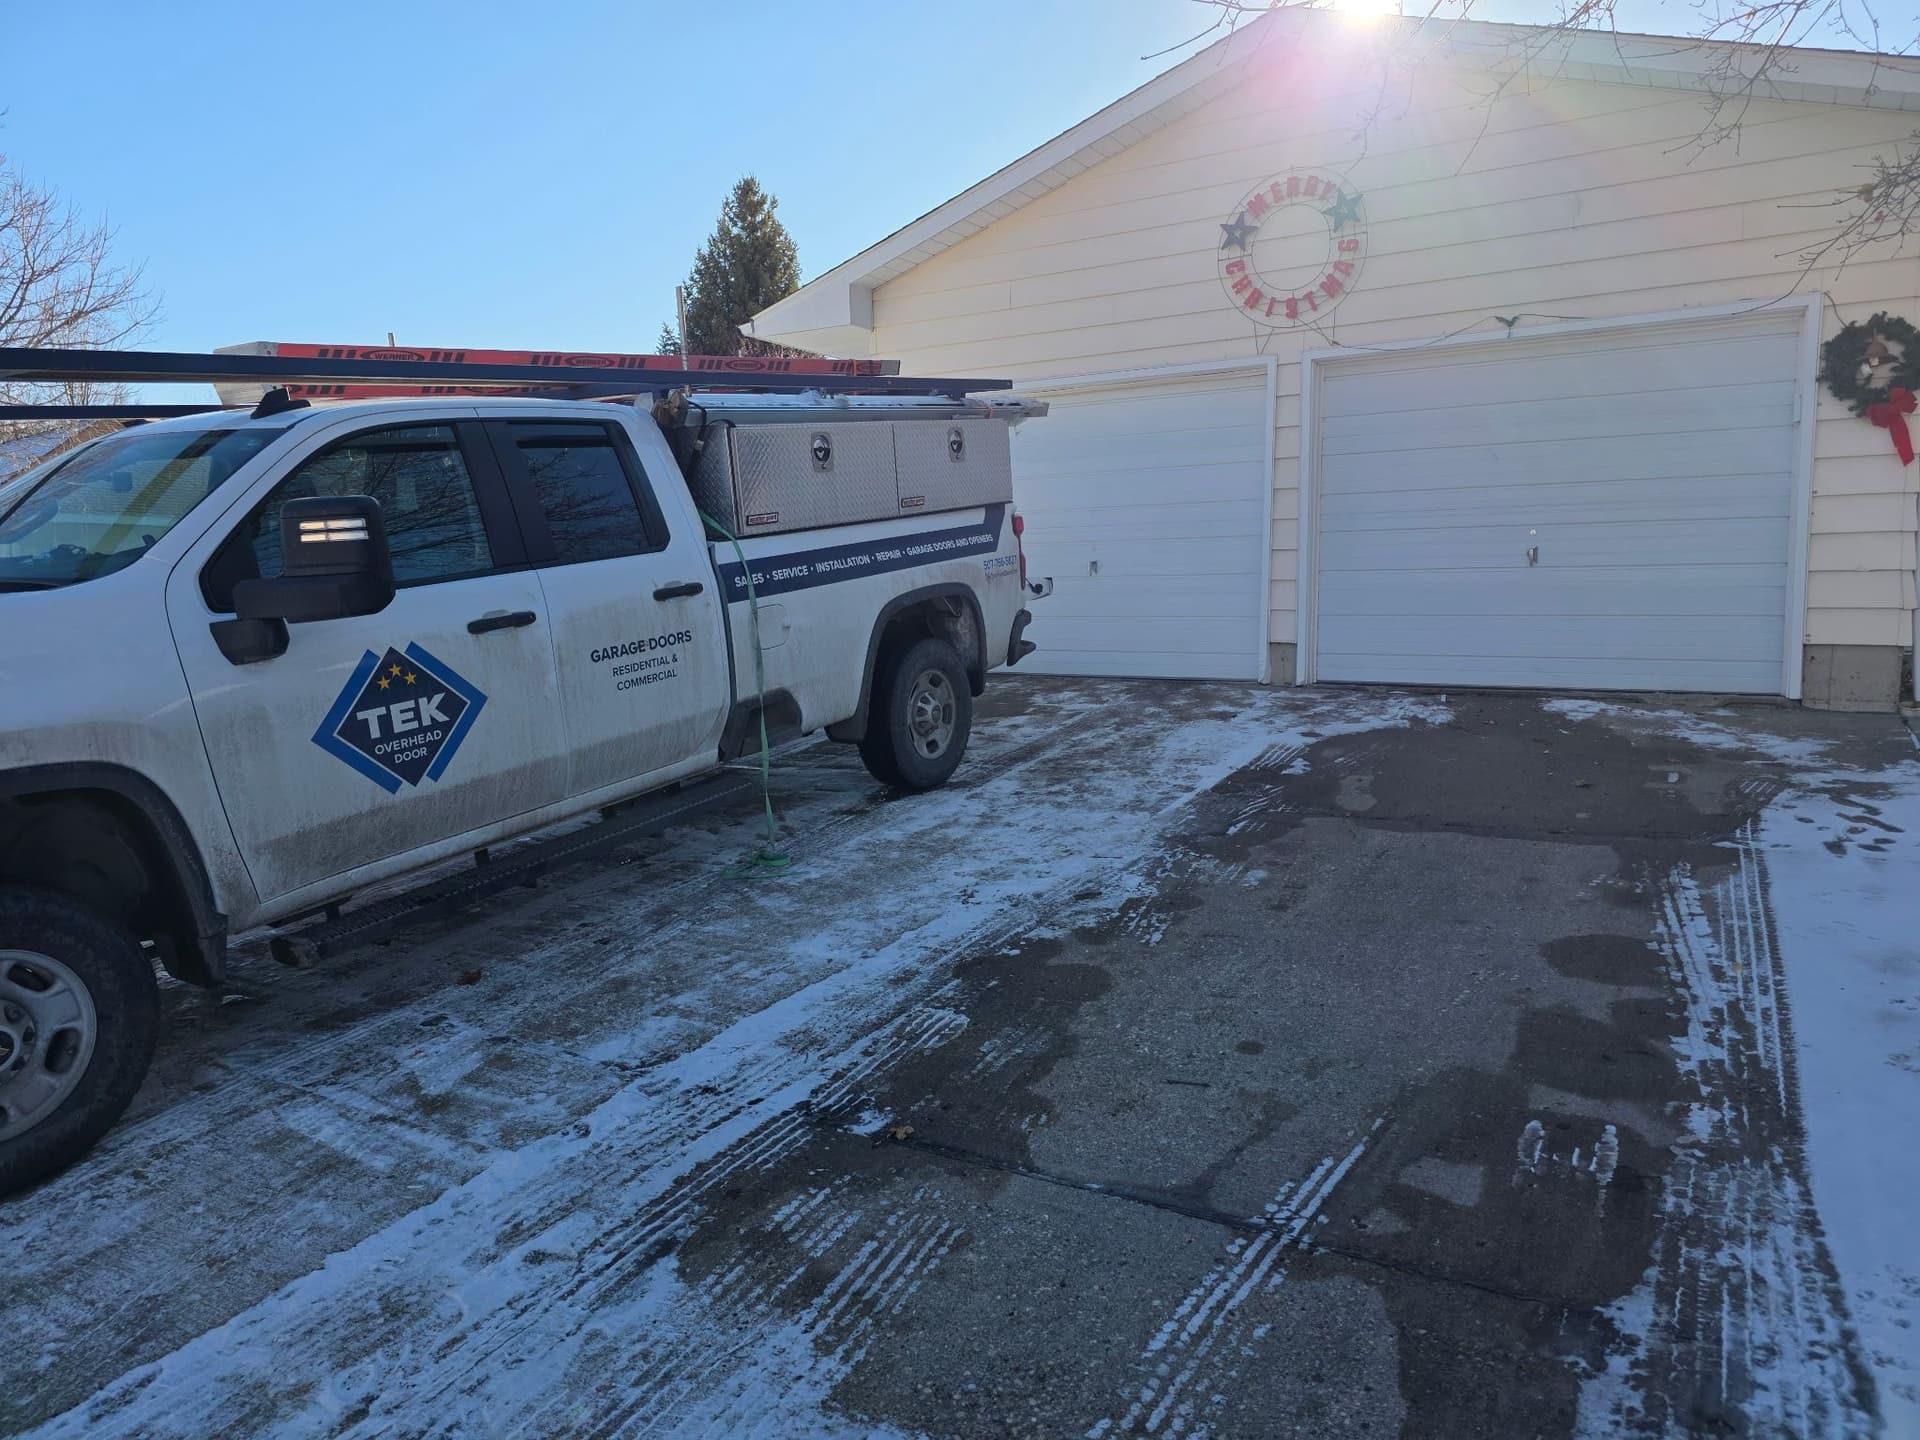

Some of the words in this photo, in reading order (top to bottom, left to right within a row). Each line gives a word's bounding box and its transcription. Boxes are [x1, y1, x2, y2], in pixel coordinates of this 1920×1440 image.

[1247, 175, 1336, 218] MERRY
[1225, 239, 1360, 320] CHRISTMAS
[734, 572, 765, 588] SAES
[772, 565, 809, 581] SERVICE
[815, 554, 871, 573] INSTALLATION
[875, 549, 902, 562] REPAIR
[906, 543, 935, 556] GARAGE
[934, 540, 956, 551] DOORS
[956, 537, 969, 547] AND
[968, 533, 994, 545] OPENERS
[590, 640, 646, 662] GARAGE
[648, 630, 692, 651] DOORS
[612, 655, 670, 677] RESIDENTIAL
[671, 653, 678, 663] &
[617, 669, 677, 691] COMMERCIAL
[356, 692, 450, 739] TEK
[375, 730, 442, 755] OVERHEAD
[394, 747, 428, 764] DOOR
